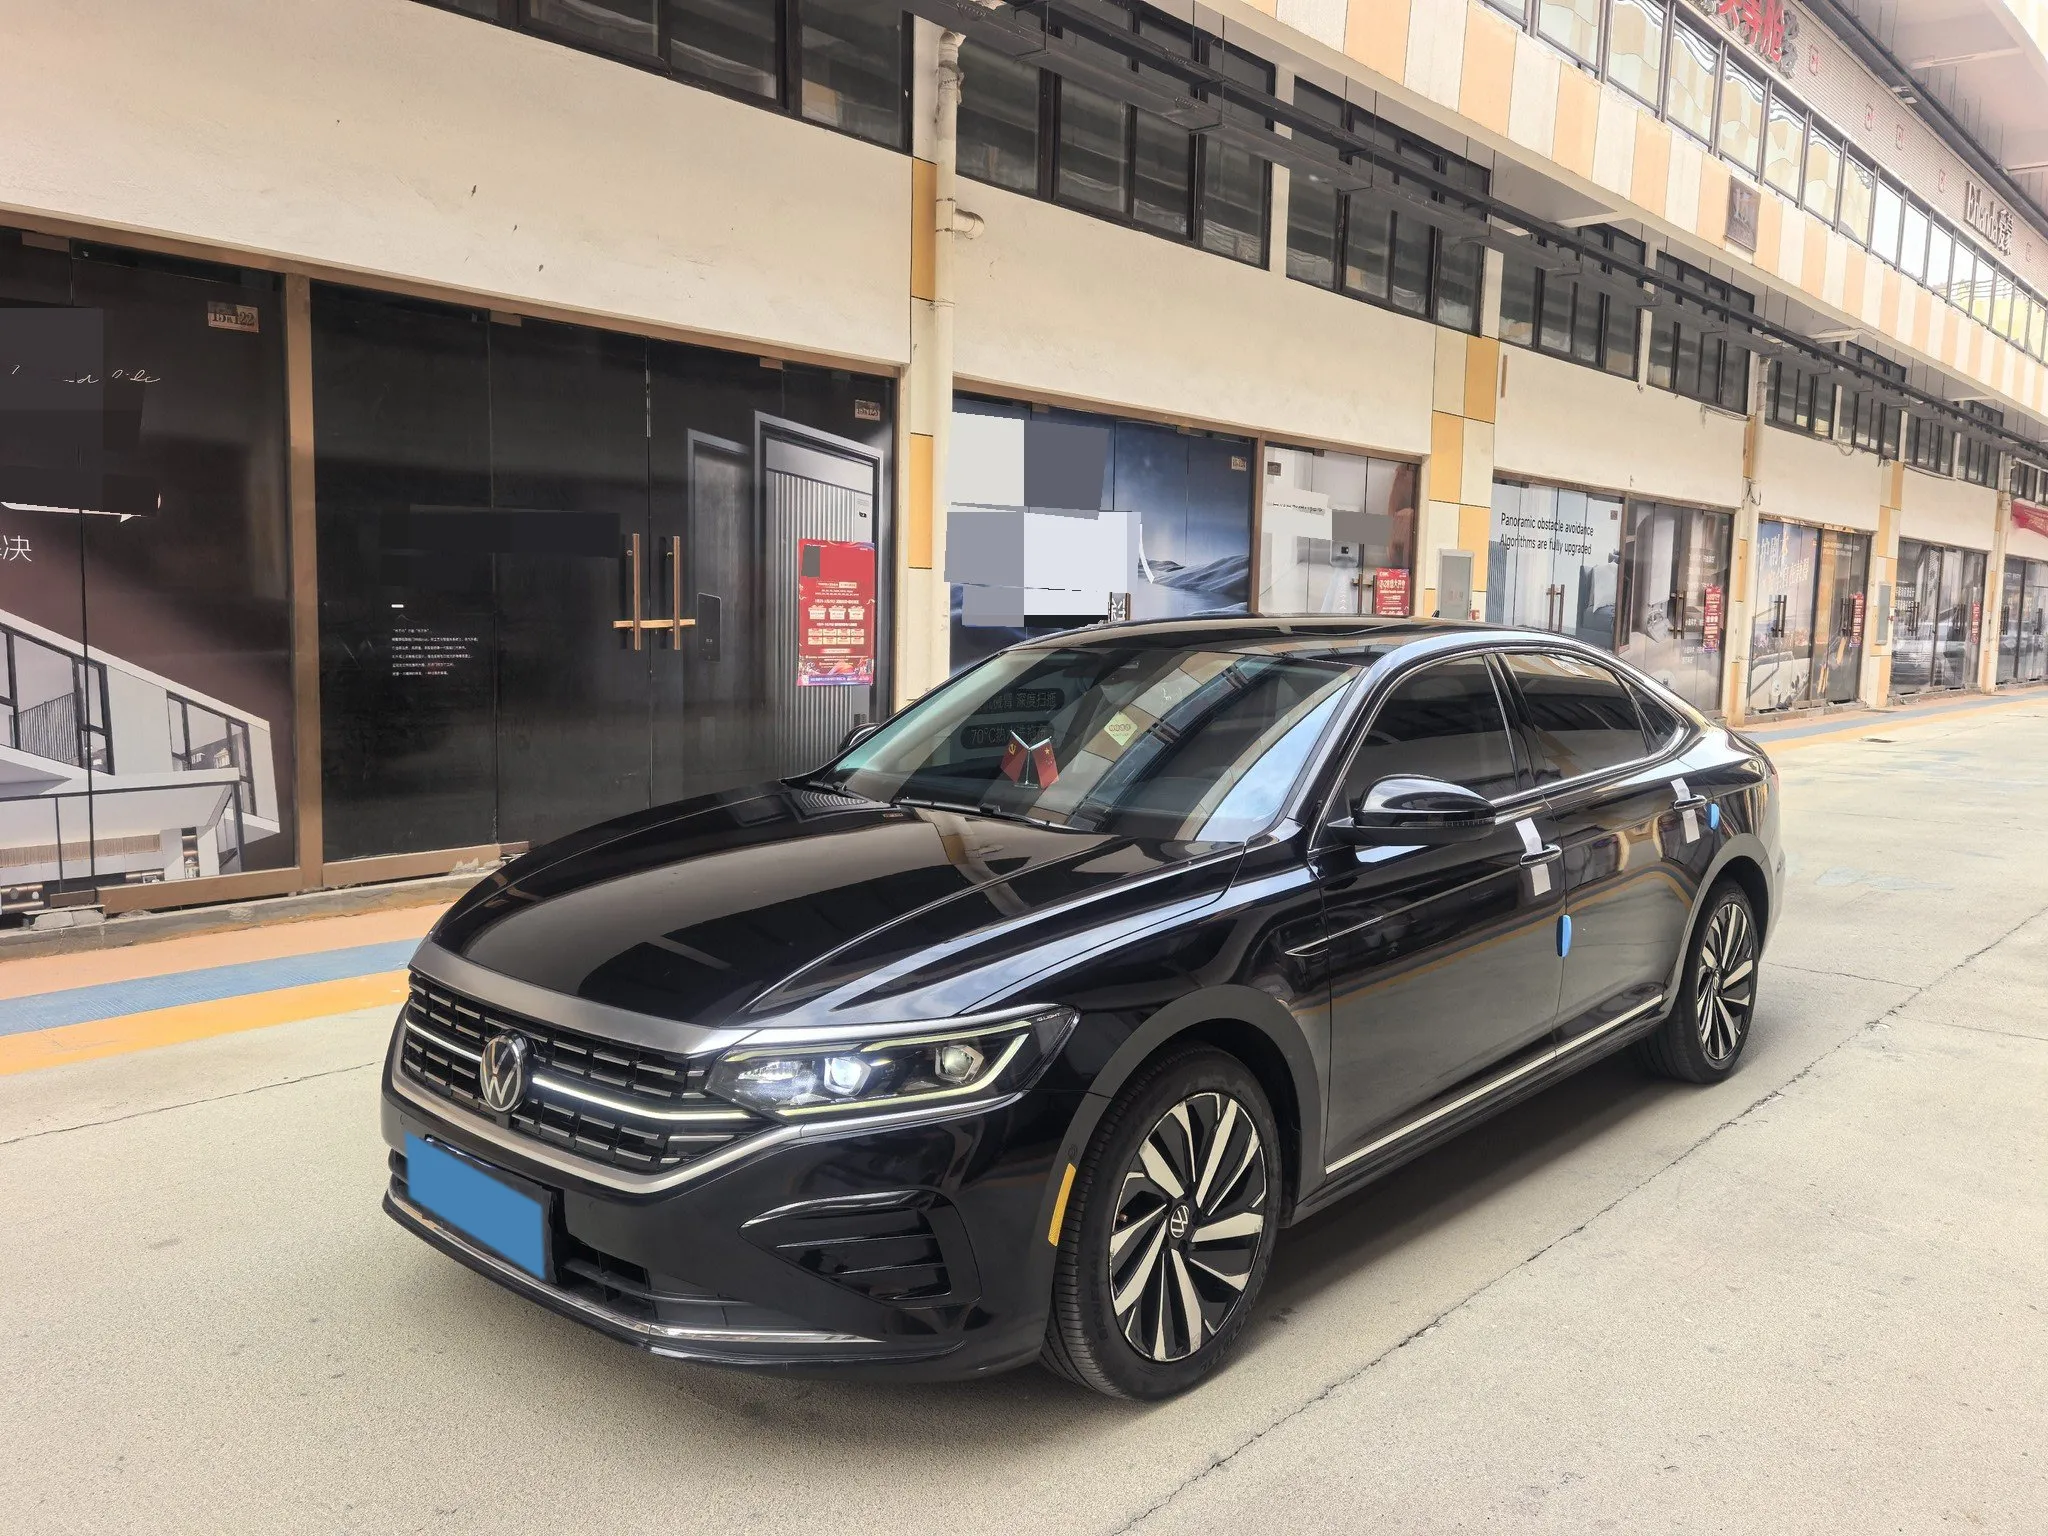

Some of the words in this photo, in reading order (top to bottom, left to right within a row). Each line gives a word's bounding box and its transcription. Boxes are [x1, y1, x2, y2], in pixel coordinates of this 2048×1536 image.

[1500, 512, 1536, 529] Panoramic
[1538, 517, 1564, 532] obstacle
[1565, 521, 1594, 537] avoidance
[0, 534, 32, 563] 决
[1500, 533, 1536, 551] Algorithms
[1538, 539, 1548, 550] are
[1549, 537, 1564, 555] fully
[1564, 543, 1592, 557] upgraded
